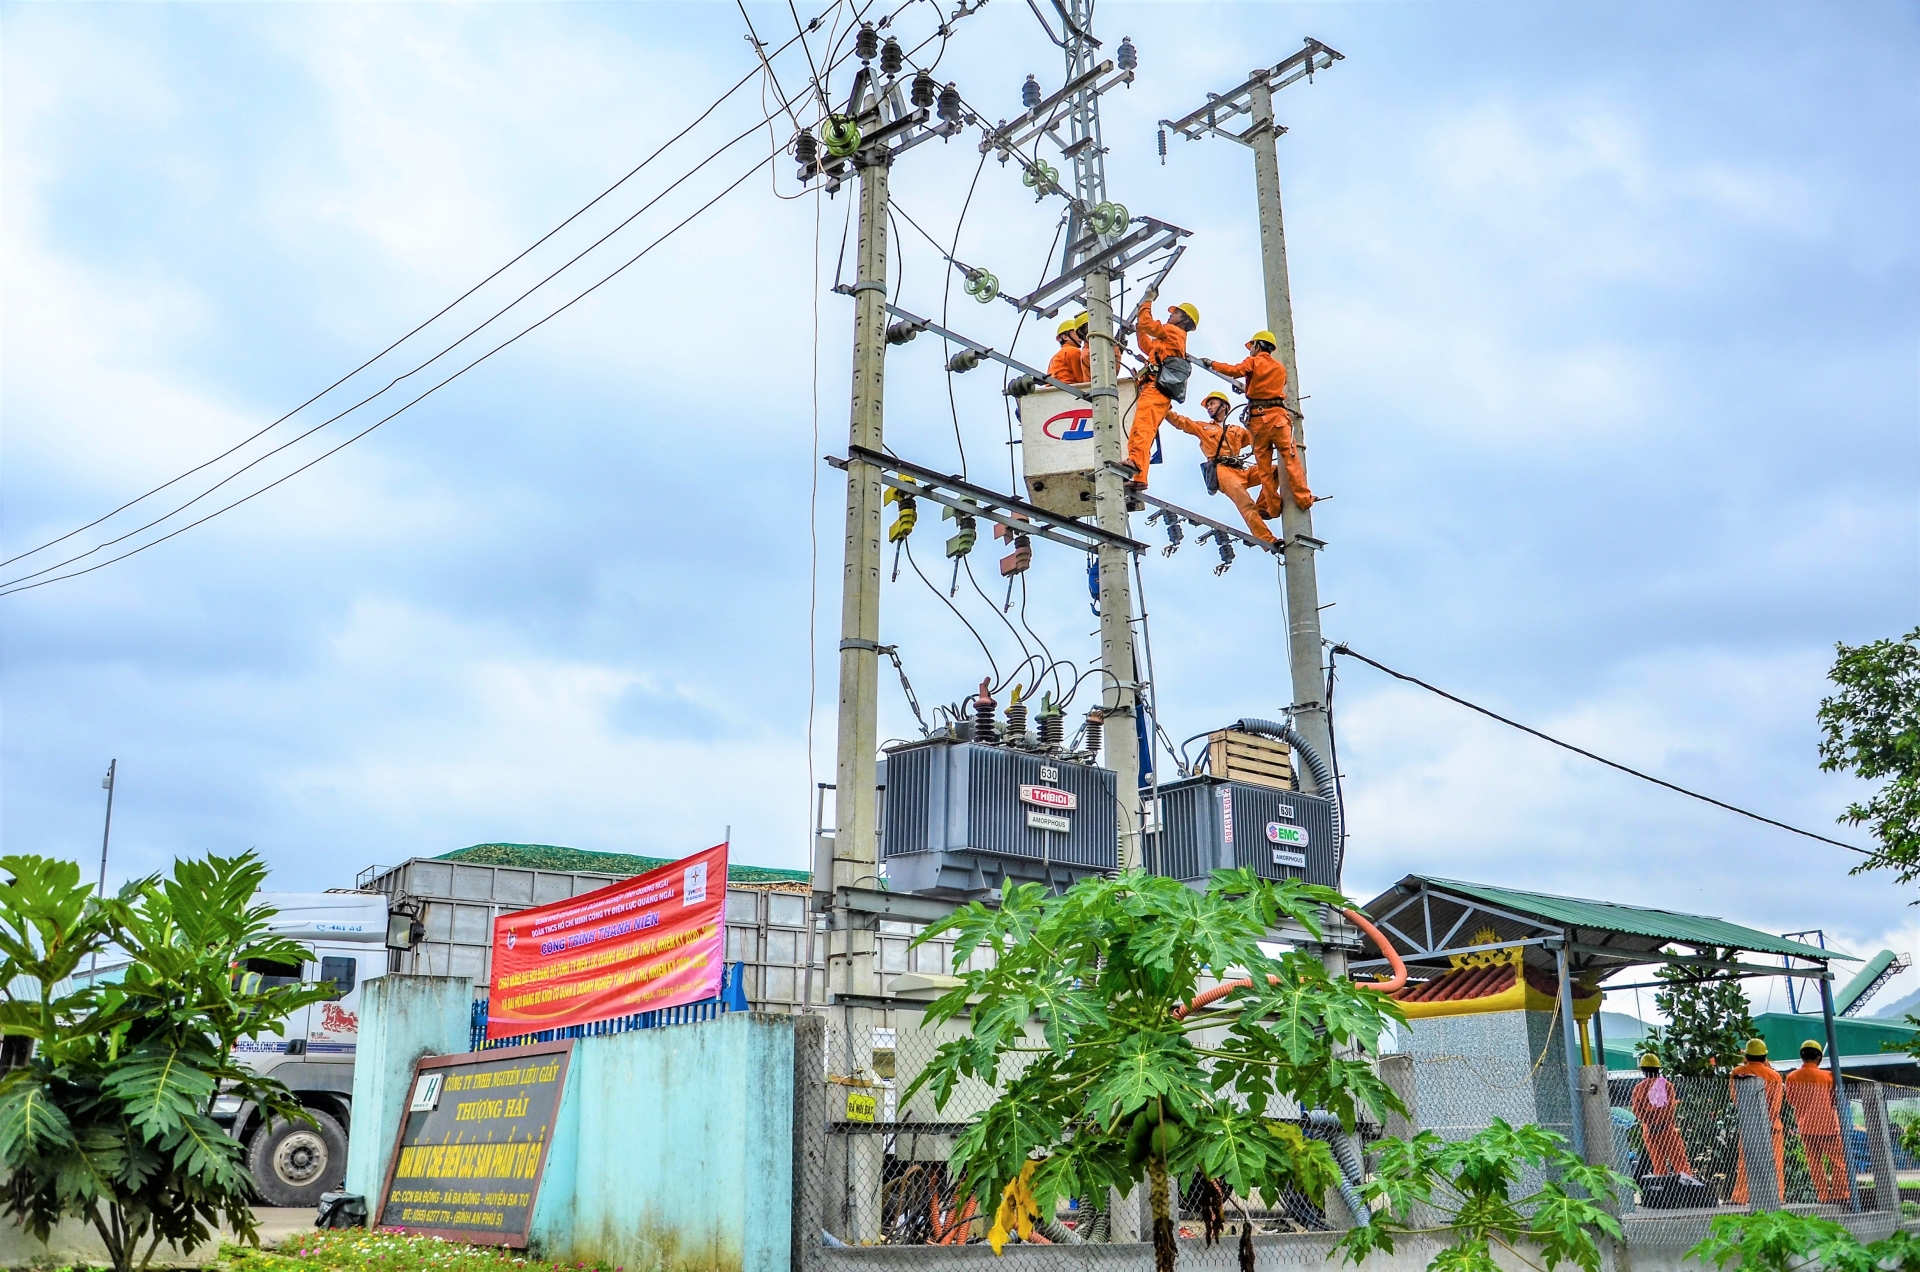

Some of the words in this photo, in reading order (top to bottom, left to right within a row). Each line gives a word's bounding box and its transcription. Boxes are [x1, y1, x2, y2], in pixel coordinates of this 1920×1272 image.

[1041, 768, 1057, 780] 630
[1033, 790, 1068, 804] THIBIDI
[1280, 805, 1293, 817] 630
[1032, 816, 1066, 828] AMORPHOUS
[1276, 854, 1303, 864] AMORPHOUS
[574, 914, 588, 925] MINH
[588, 910, 603, 922] CÔNG
[604, 908, 612, 917] TY
[611, 904, 625, 915] ĐIỆN
[637, 894, 659, 907] QUẢNG
[541, 938, 565, 956] CÔNG
[567, 930, 597, 949] TRÌNH
[598, 919, 633, 940] THANH
[632, 911, 660, 931] NIÊN
[444, 1073, 462, 1091] CÔNG
[462, 1075, 474, 1090] TY
[472, 1072, 493, 1089] TNHH
[491, 1066, 521, 1087] NGUYÊN
[520, 1063, 540, 1087] LIỆU
[539, 1058, 560, 1083] GIẤY
[455, 1098, 503, 1124] THƯỢNG
[503, 1090, 530, 1118] HẢI
[451, 1192, 462, 1204] BA
[483, 1189, 508, 1208] HUYỆN
[507, 1193, 518, 1206] BA
[471, 1211, 481, 1224] AN
[481, 1209, 496, 1226] PHÚ
[495, 1212, 504, 1228] 5)
